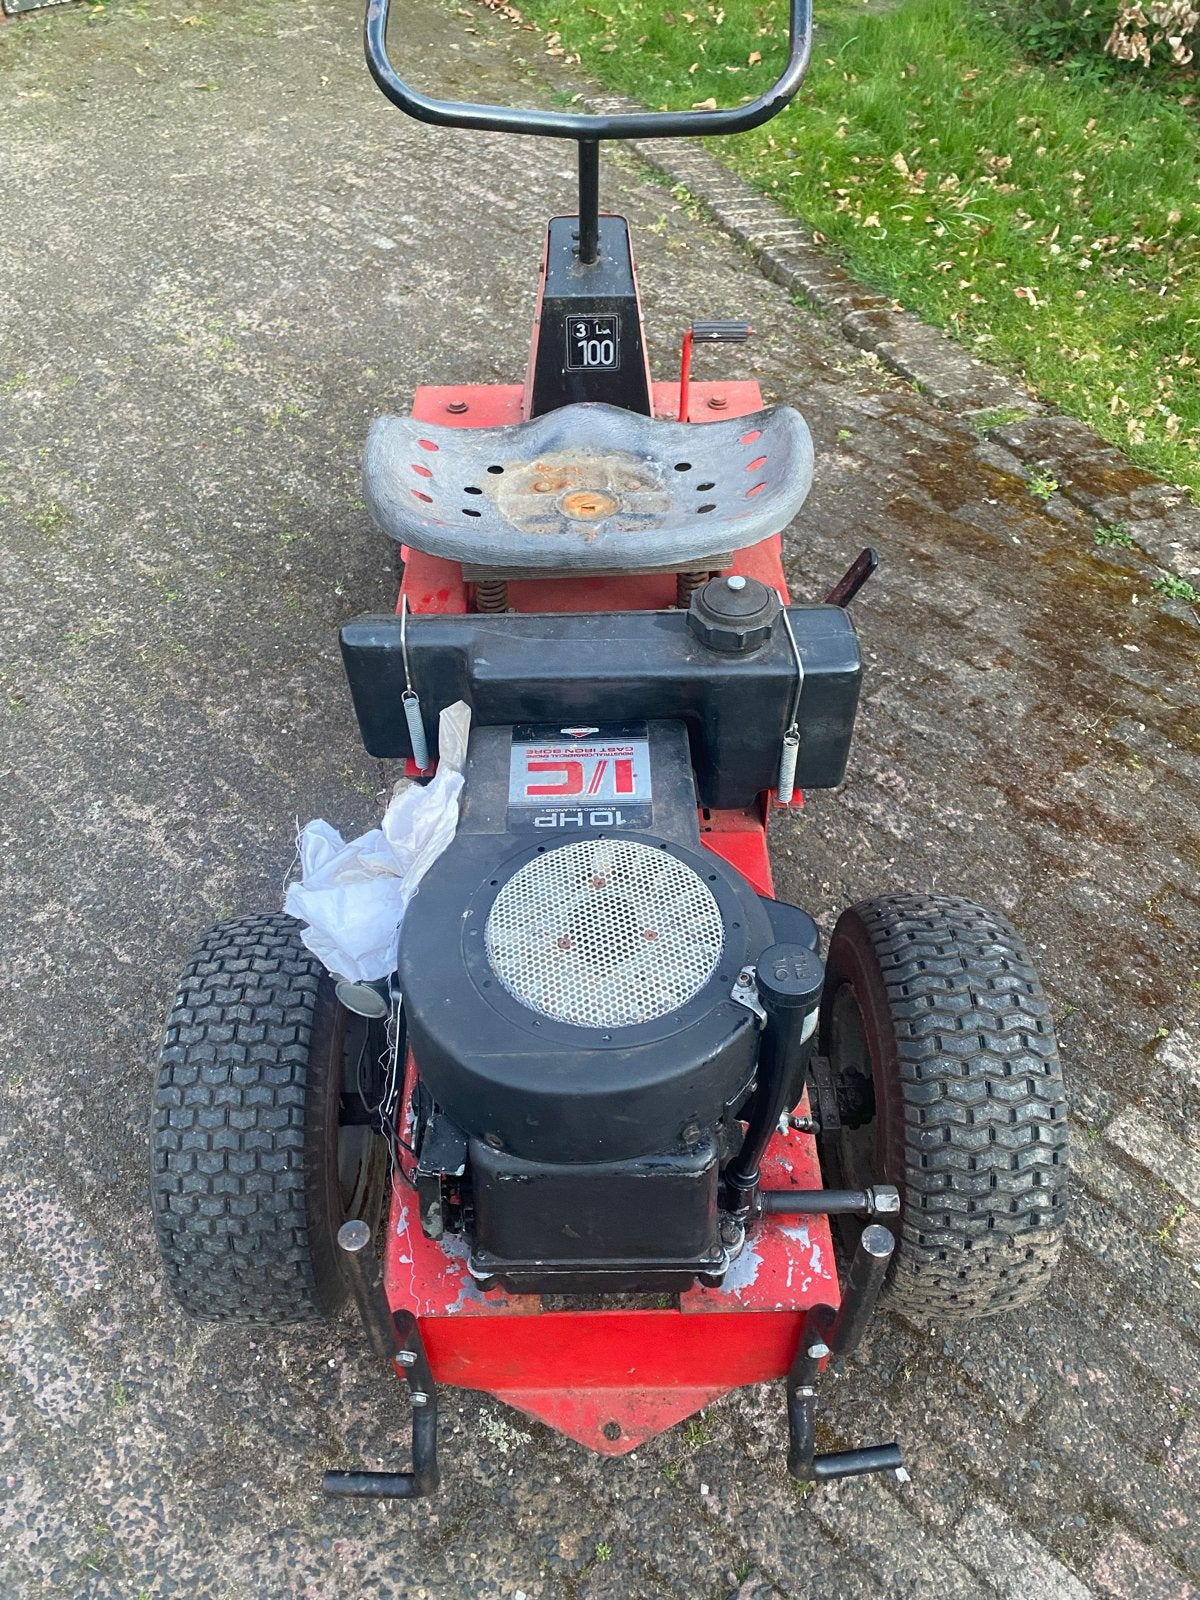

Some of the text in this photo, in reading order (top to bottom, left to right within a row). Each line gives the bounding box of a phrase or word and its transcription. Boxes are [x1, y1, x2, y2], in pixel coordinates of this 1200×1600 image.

[576, 323, 586, 337] 3
[577, 340, 614, 365] 100
[534, 811, 627, 827] 10 HP
[774, 955, 788, 981] OIL
